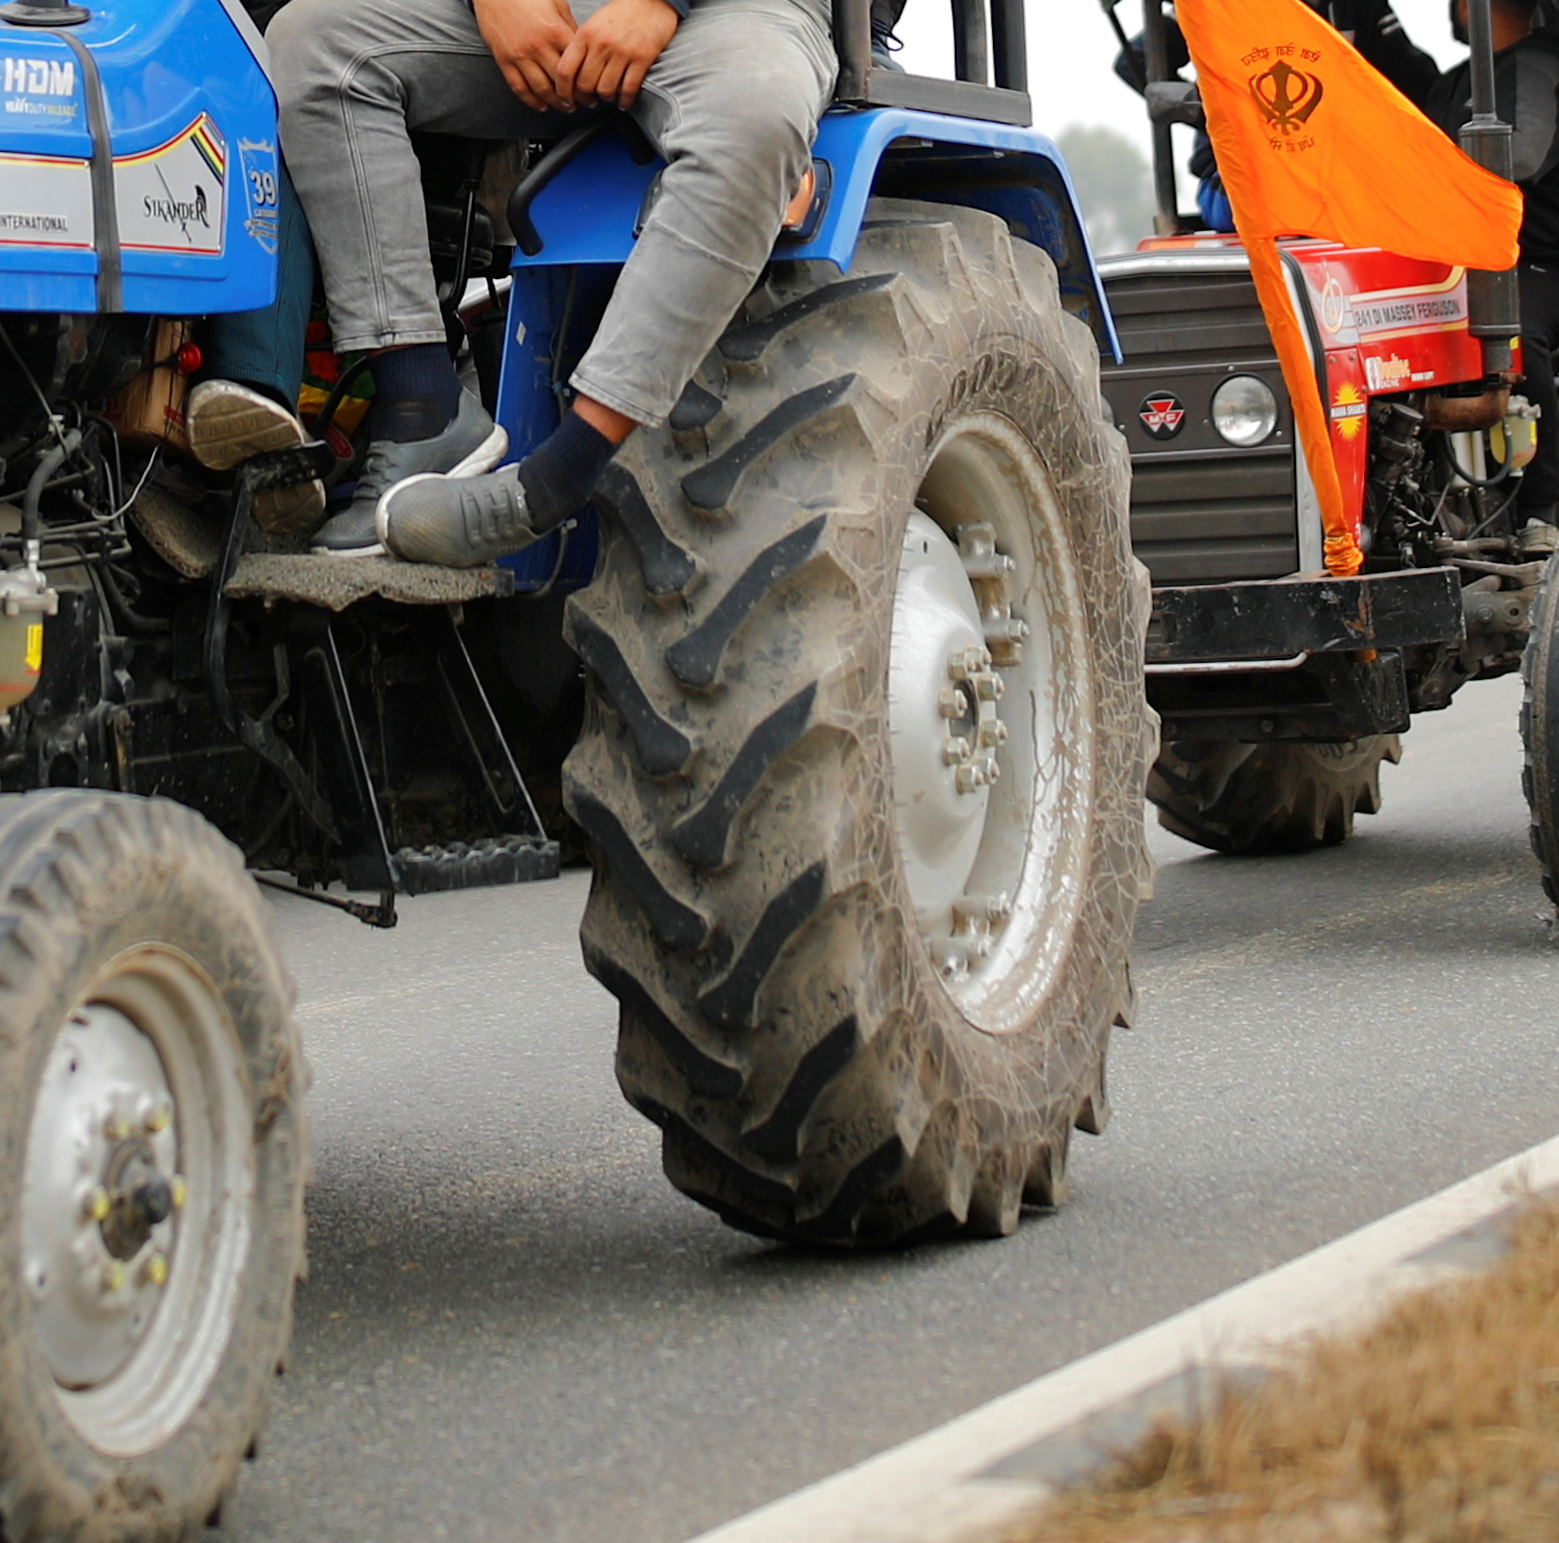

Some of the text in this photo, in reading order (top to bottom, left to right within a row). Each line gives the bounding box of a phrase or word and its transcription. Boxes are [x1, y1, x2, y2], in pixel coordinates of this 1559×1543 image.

[4, 57, 74, 96] HDM
[250, 171, 277, 206] 39
[144, 186, 210, 229] SIKANDER
[1355, 299, 1461, 327] 241 DI MASSEY FERGUSON
